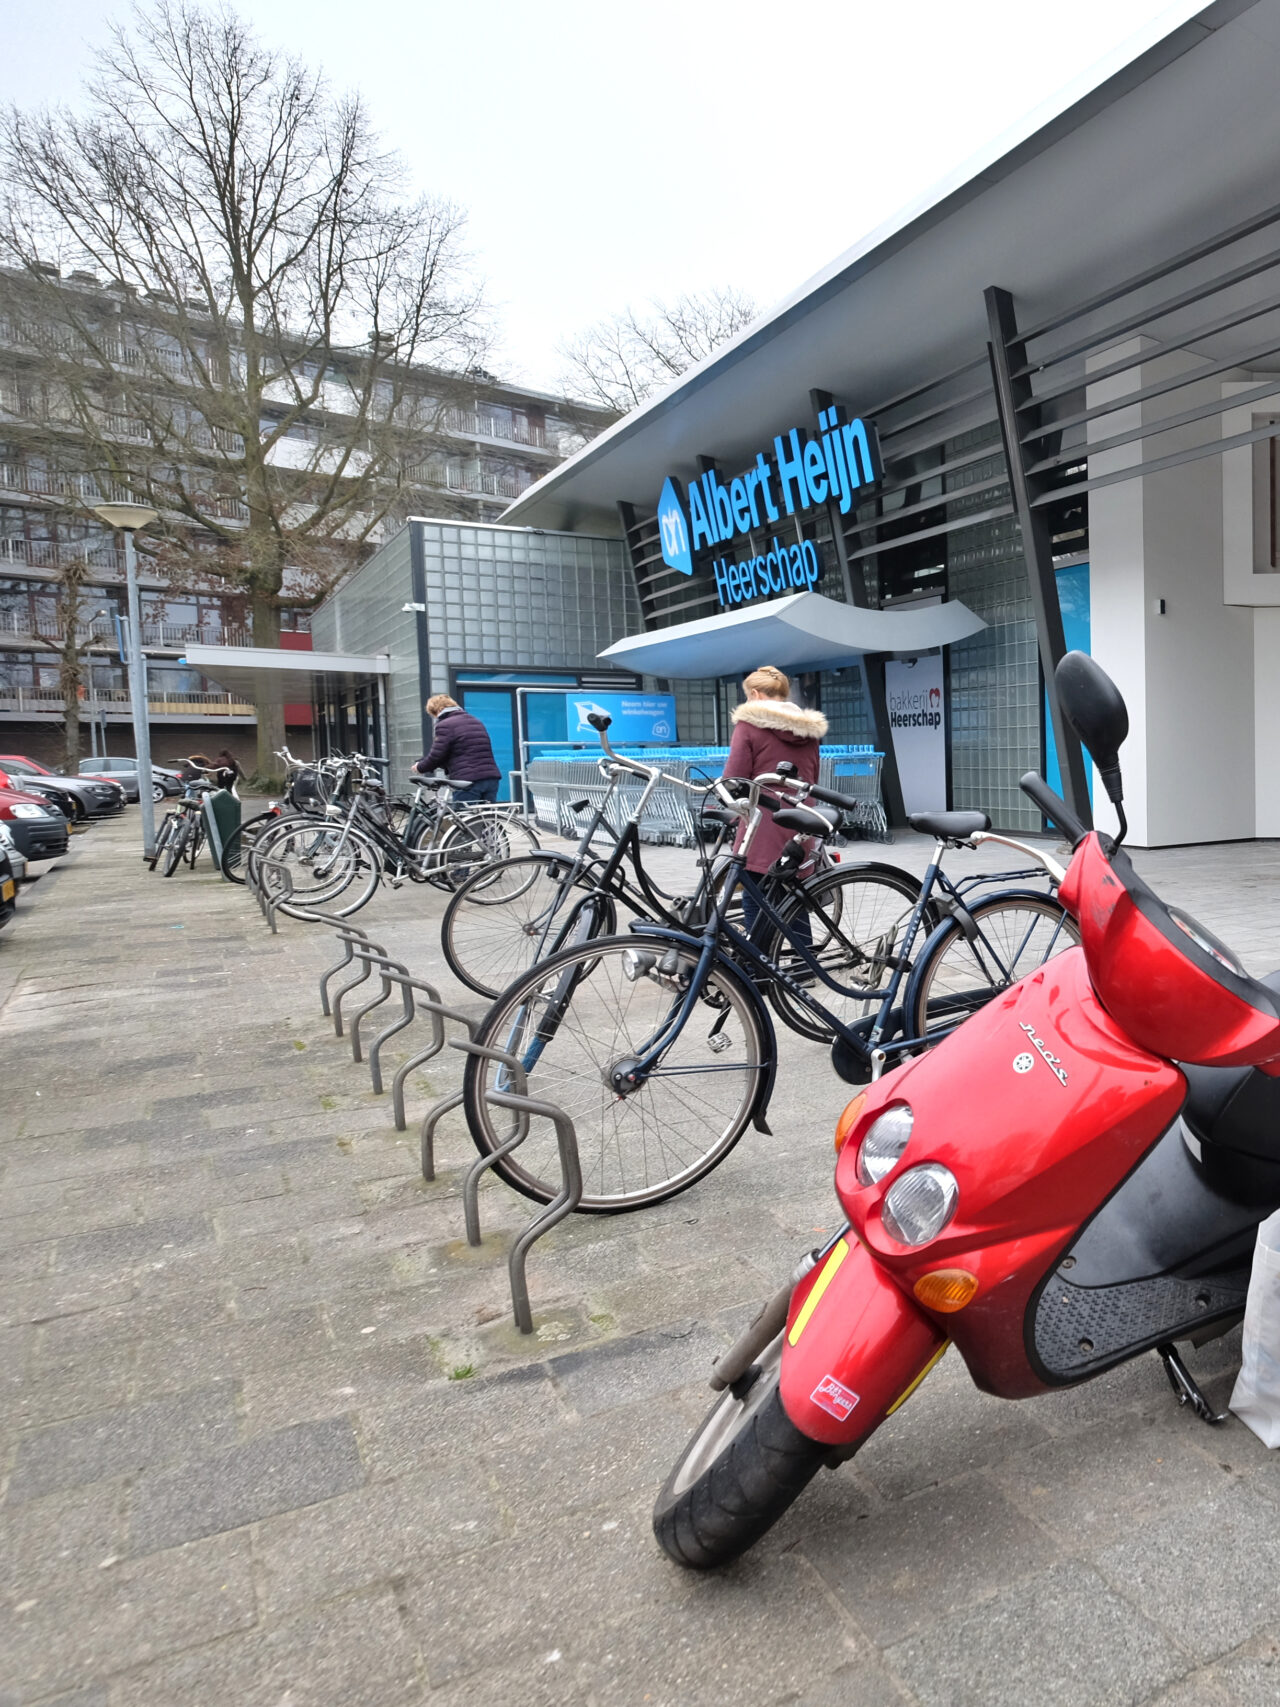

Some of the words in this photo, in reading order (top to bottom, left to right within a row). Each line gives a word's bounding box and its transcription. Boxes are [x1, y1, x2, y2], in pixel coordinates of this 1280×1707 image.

[688, 452, 779, 551] Albert
[774, 405, 874, 515] Heijn
[713, 536, 818, 606] Heerschap
[889, 688, 928, 713] bakkerij
[891, 709, 941, 730] Heerschap
